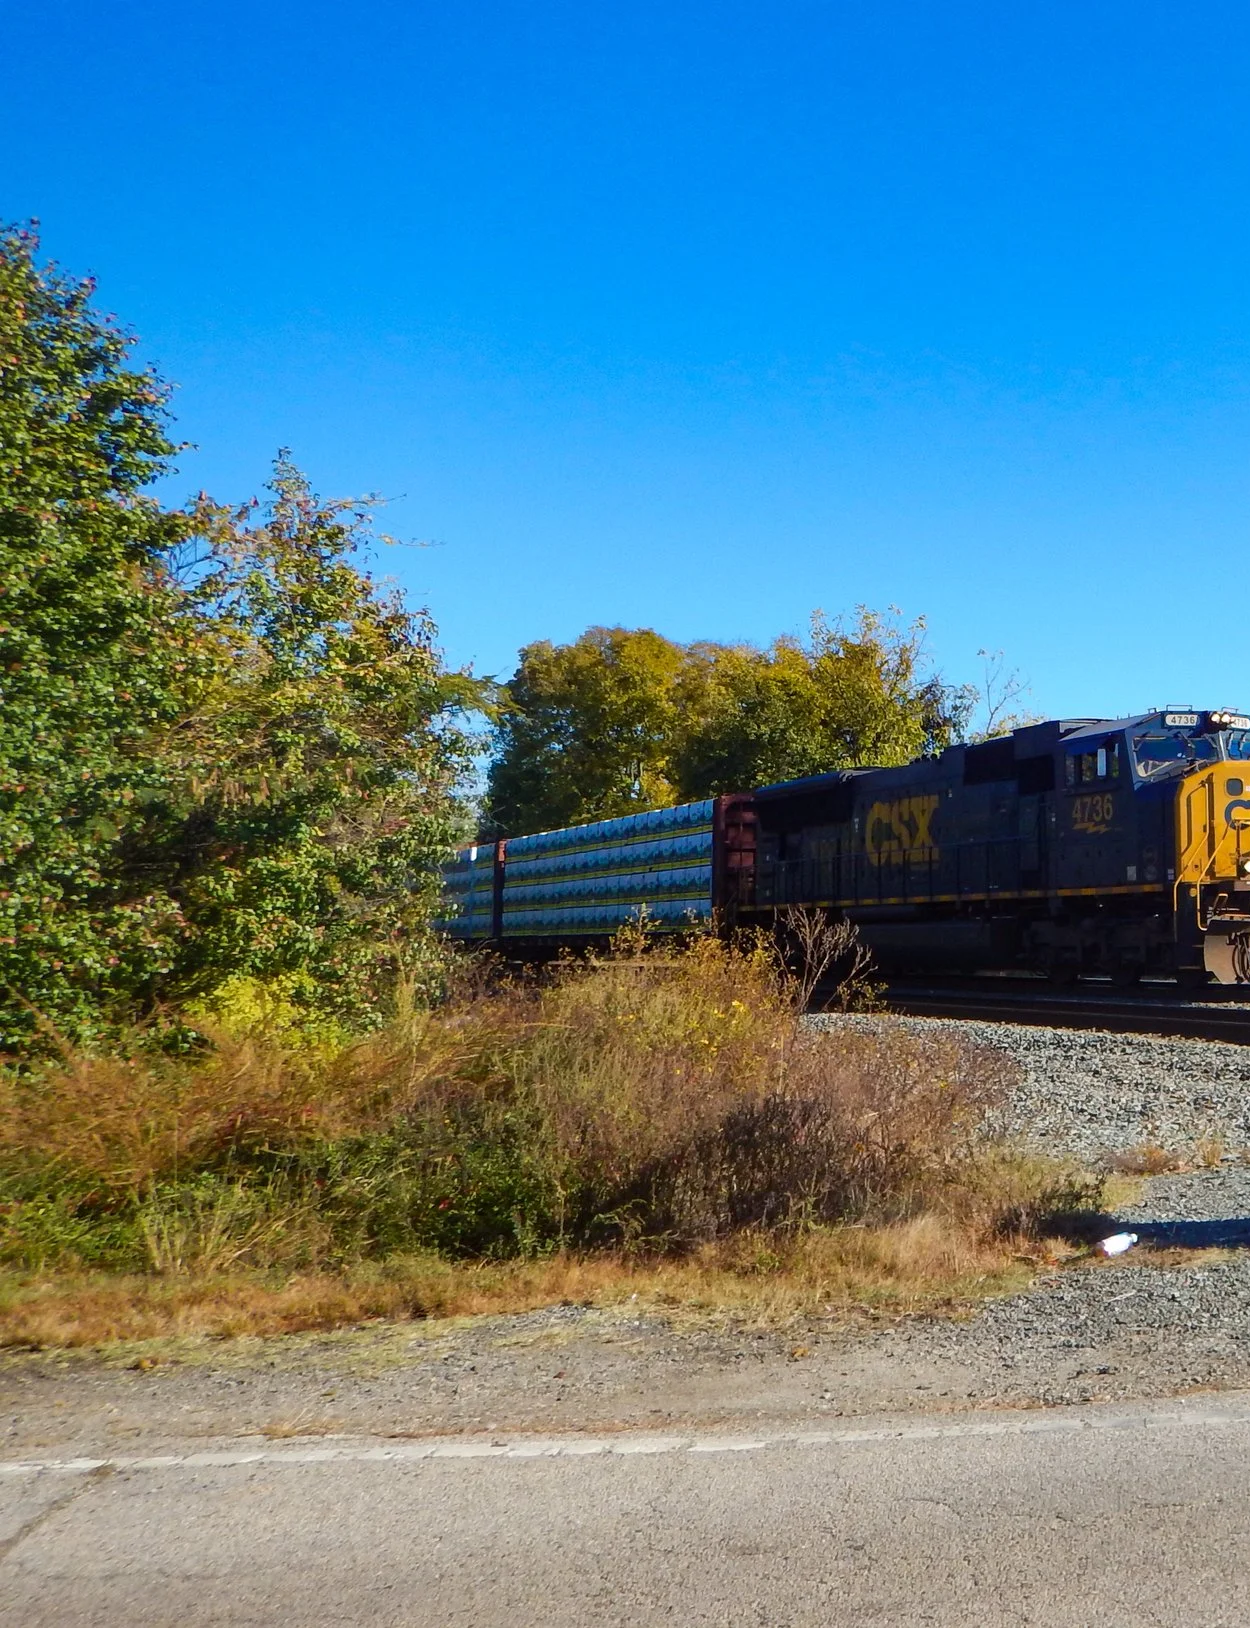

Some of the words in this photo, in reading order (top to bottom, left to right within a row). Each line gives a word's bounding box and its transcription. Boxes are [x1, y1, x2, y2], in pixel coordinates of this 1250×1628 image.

[1170, 715, 1196, 725] 4736
[1072, 793, 1113, 823] 4736
[865, 794, 940, 868] CSX
